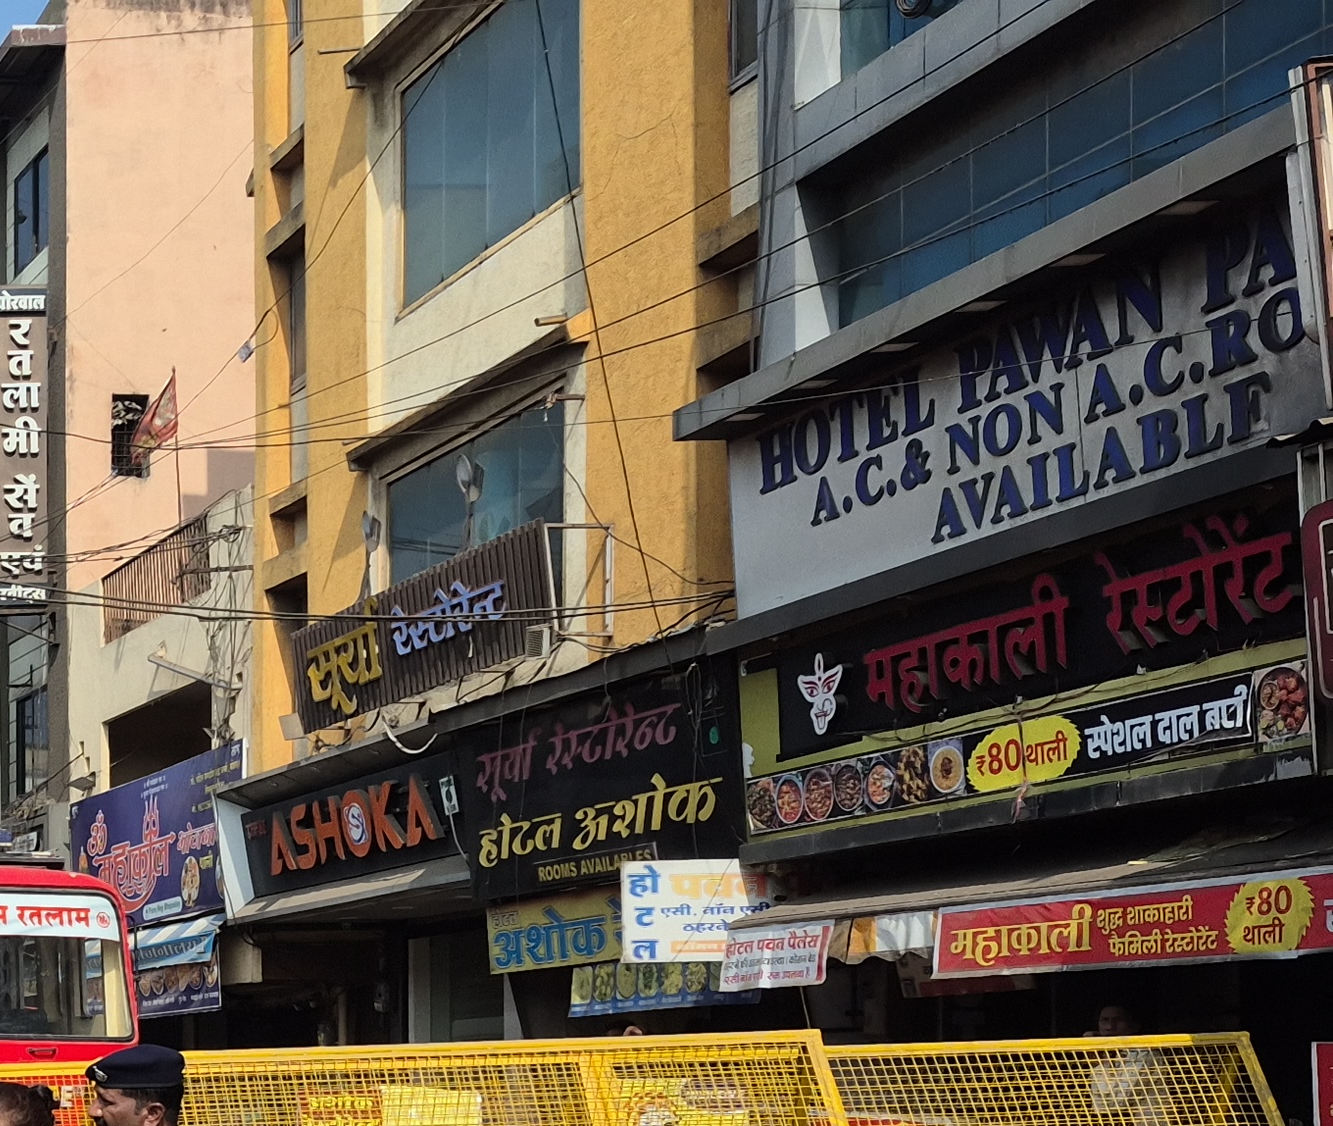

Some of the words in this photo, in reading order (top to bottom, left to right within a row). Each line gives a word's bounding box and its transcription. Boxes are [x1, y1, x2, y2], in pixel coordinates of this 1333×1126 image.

[757, 362, 935, 496] HOTEL
[955, 268, 1164, 415] PAWAN
[1201, 200, 1299, 314] PA
[945, 381, 1065, 475] NON
[863, 573, 1071, 714] महाकाली
[1024, 729, 1068, 769] थाली
[1086, 712, 1152, 760] स्पेशल
[1157, 706, 1199, 746] दाल
[270, 772, 439, 876] ASHOKA
[478, 812, 563, 868] होटल
[572, 772, 724, 852] अशोक
[537, 861, 579, 883] ROOMS
[16, 904, 92, 928] रतलाम
[493, 904, 607, 969] अशोक
[949, 903, 1093, 964] महाकाली
[1127, 895, 1194, 926] शाकाहारी
[1242, 916, 1286, 946] थाली
[725, 937, 755, 960] होटल
[1108, 927, 1163, 957] फैमिली
